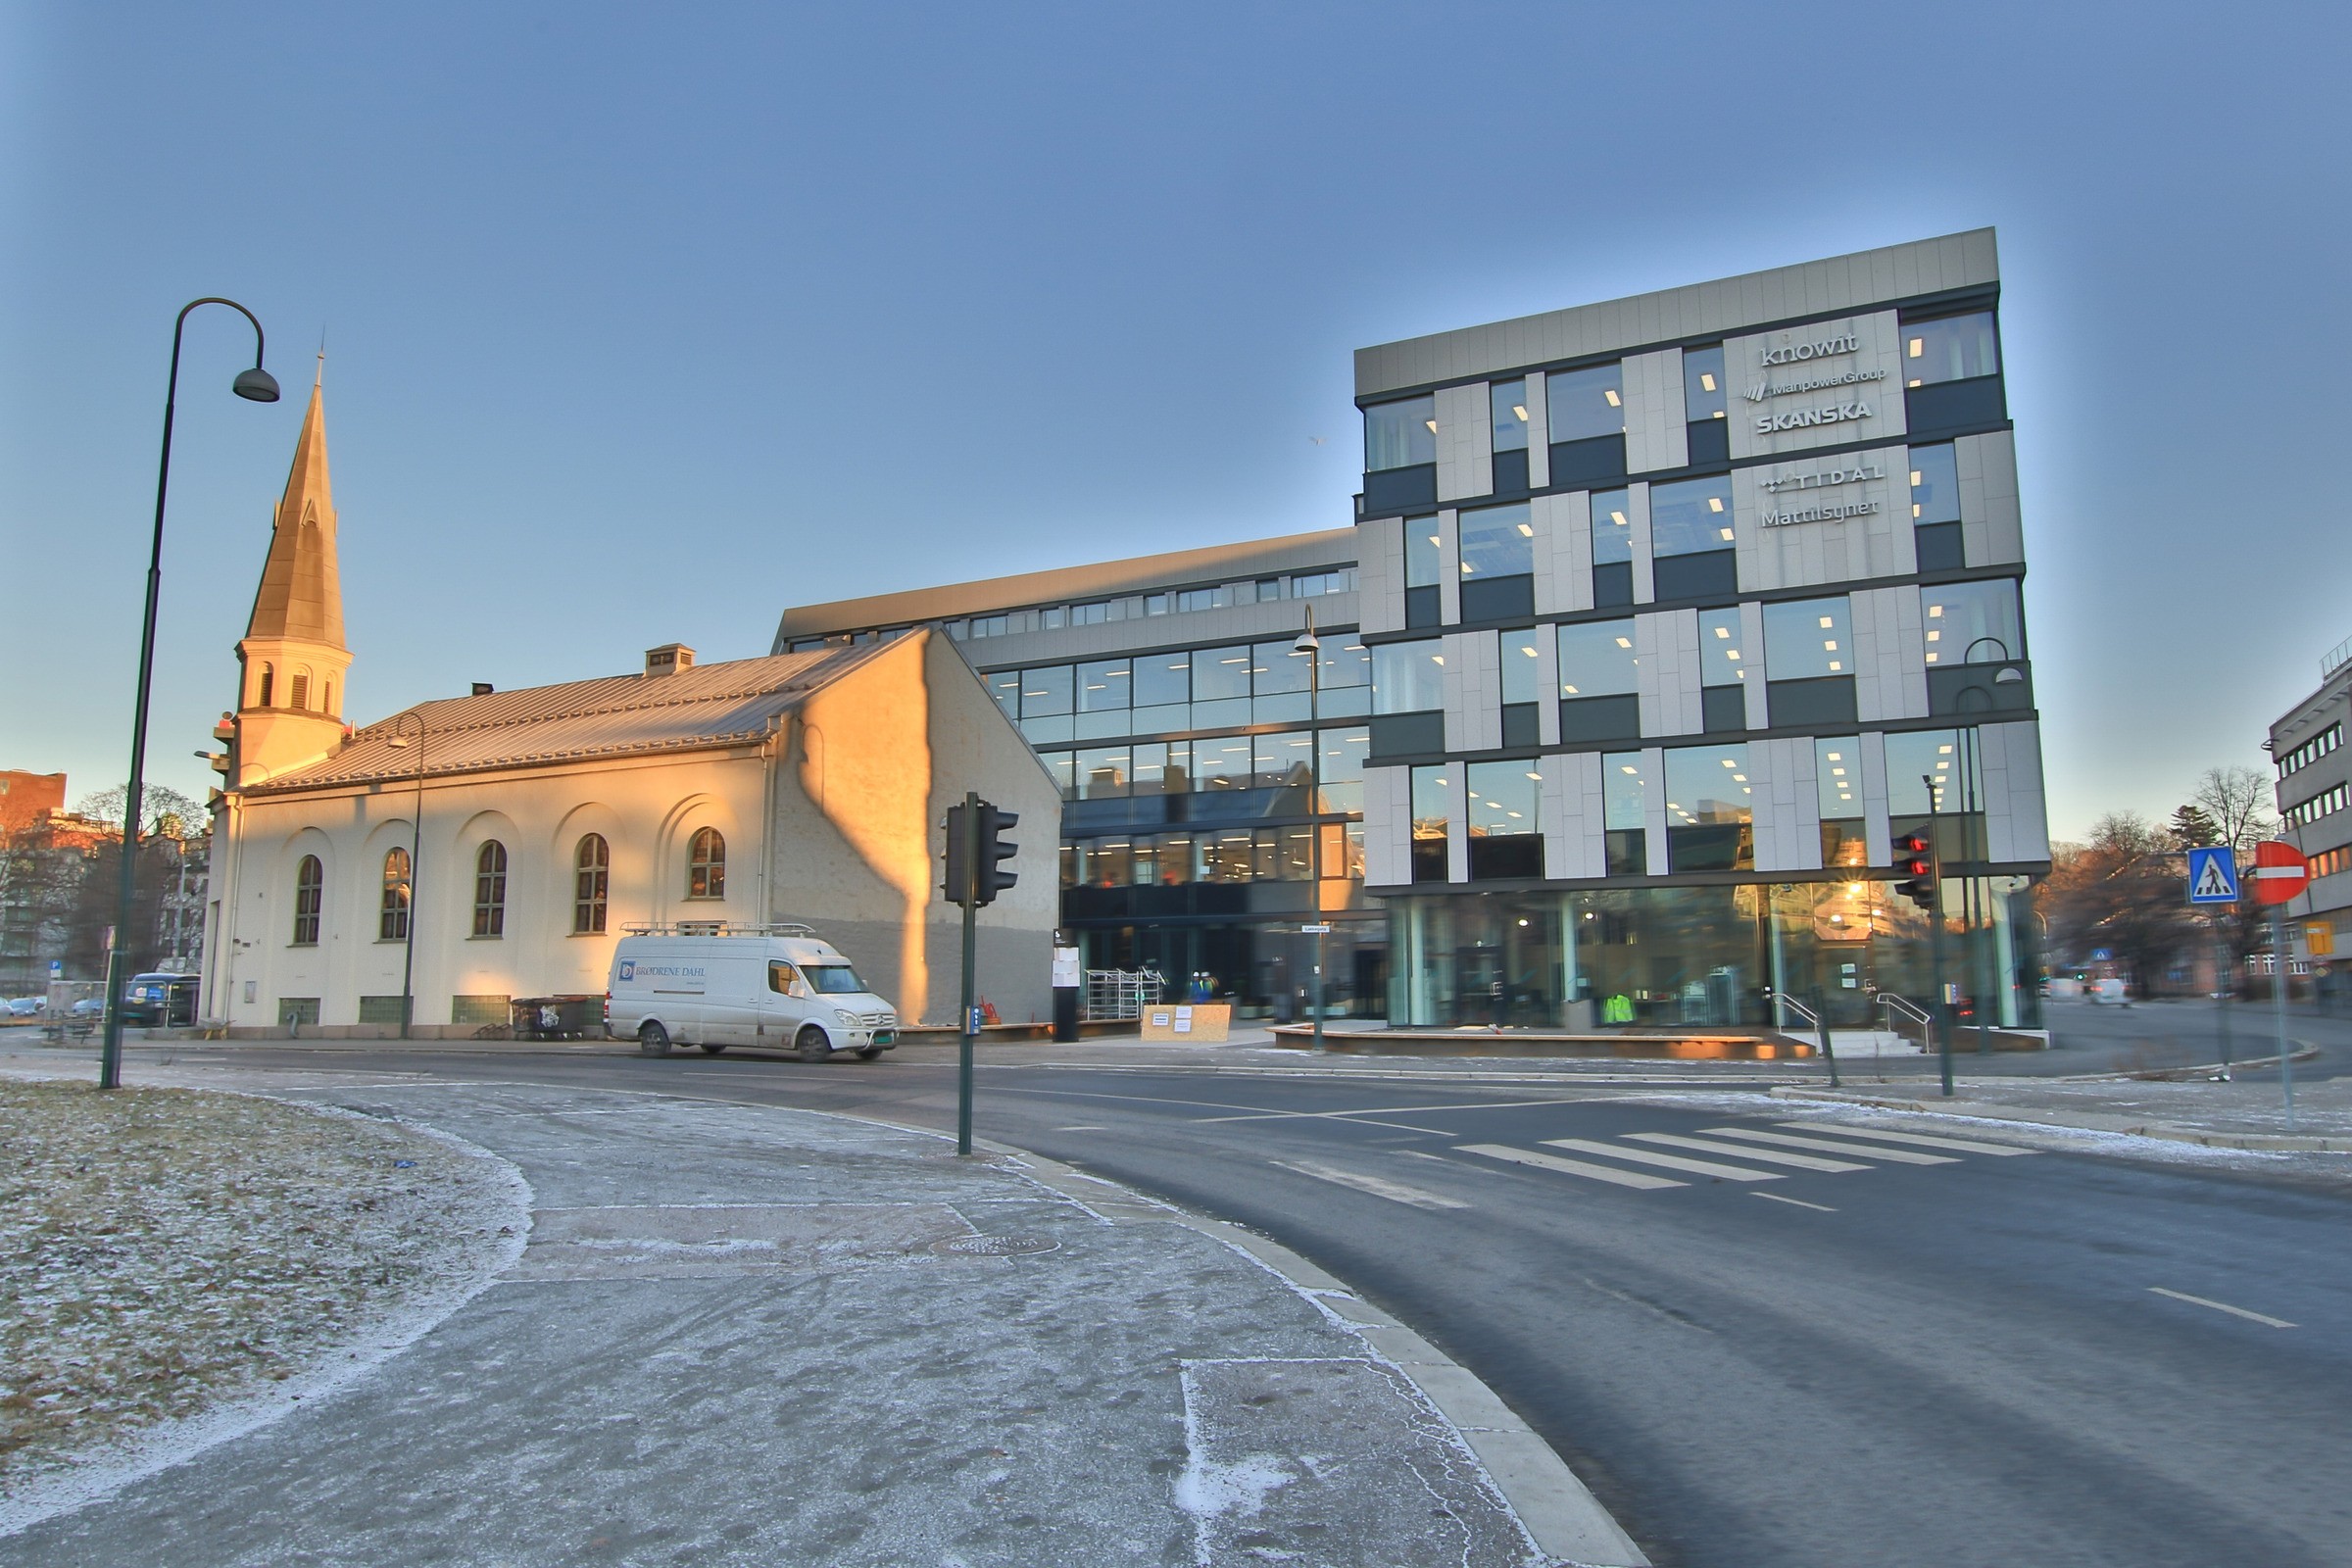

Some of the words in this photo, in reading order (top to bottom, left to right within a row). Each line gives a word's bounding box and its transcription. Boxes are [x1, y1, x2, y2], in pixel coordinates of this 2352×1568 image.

[1760, 333, 1859, 367] knowit
[1772, 368, 1887, 395] ManpowerGroup
[1756, 402, 1873, 434] SKANSKA
[1794, 466, 1886, 489] TIDAL
[1761, 501, 1879, 527] Mattilsynet
[635, 966, 680, 976] BRØDRENE
[681, 967, 706, 977] DAHL
